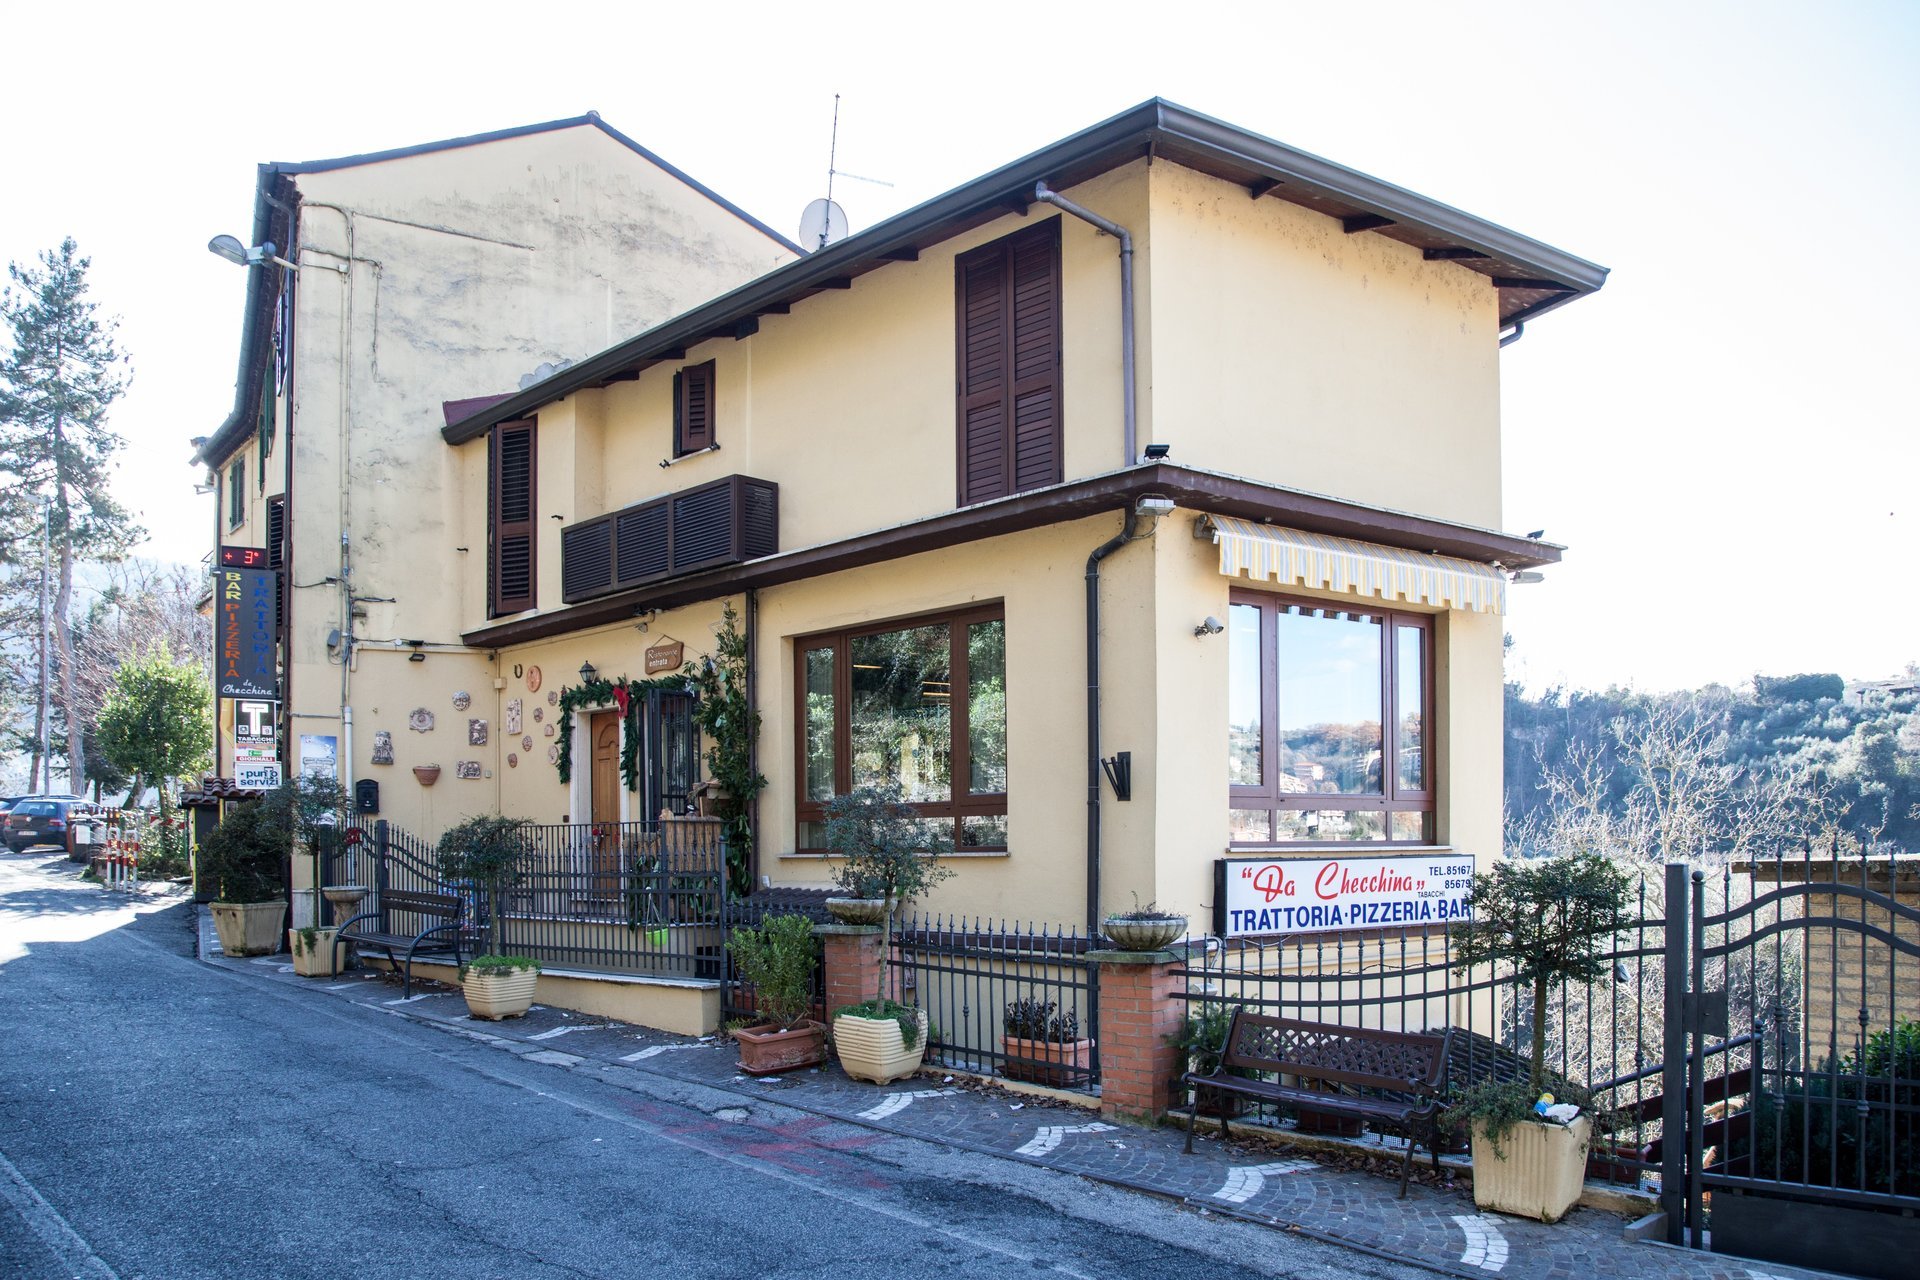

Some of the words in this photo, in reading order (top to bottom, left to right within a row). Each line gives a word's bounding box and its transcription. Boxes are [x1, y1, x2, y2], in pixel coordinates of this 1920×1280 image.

[226, 572, 241, 600] BAR
[253, 576, 269, 676] TRATTORIA
[225, 603, 240, 678] PIZZERIA
[222, 684, 272, 695] Checchina
[241, 703, 268, 735] T
[240, 778, 279, 786] servizi
[1417, 890, 1446, 899] TABACCHI
